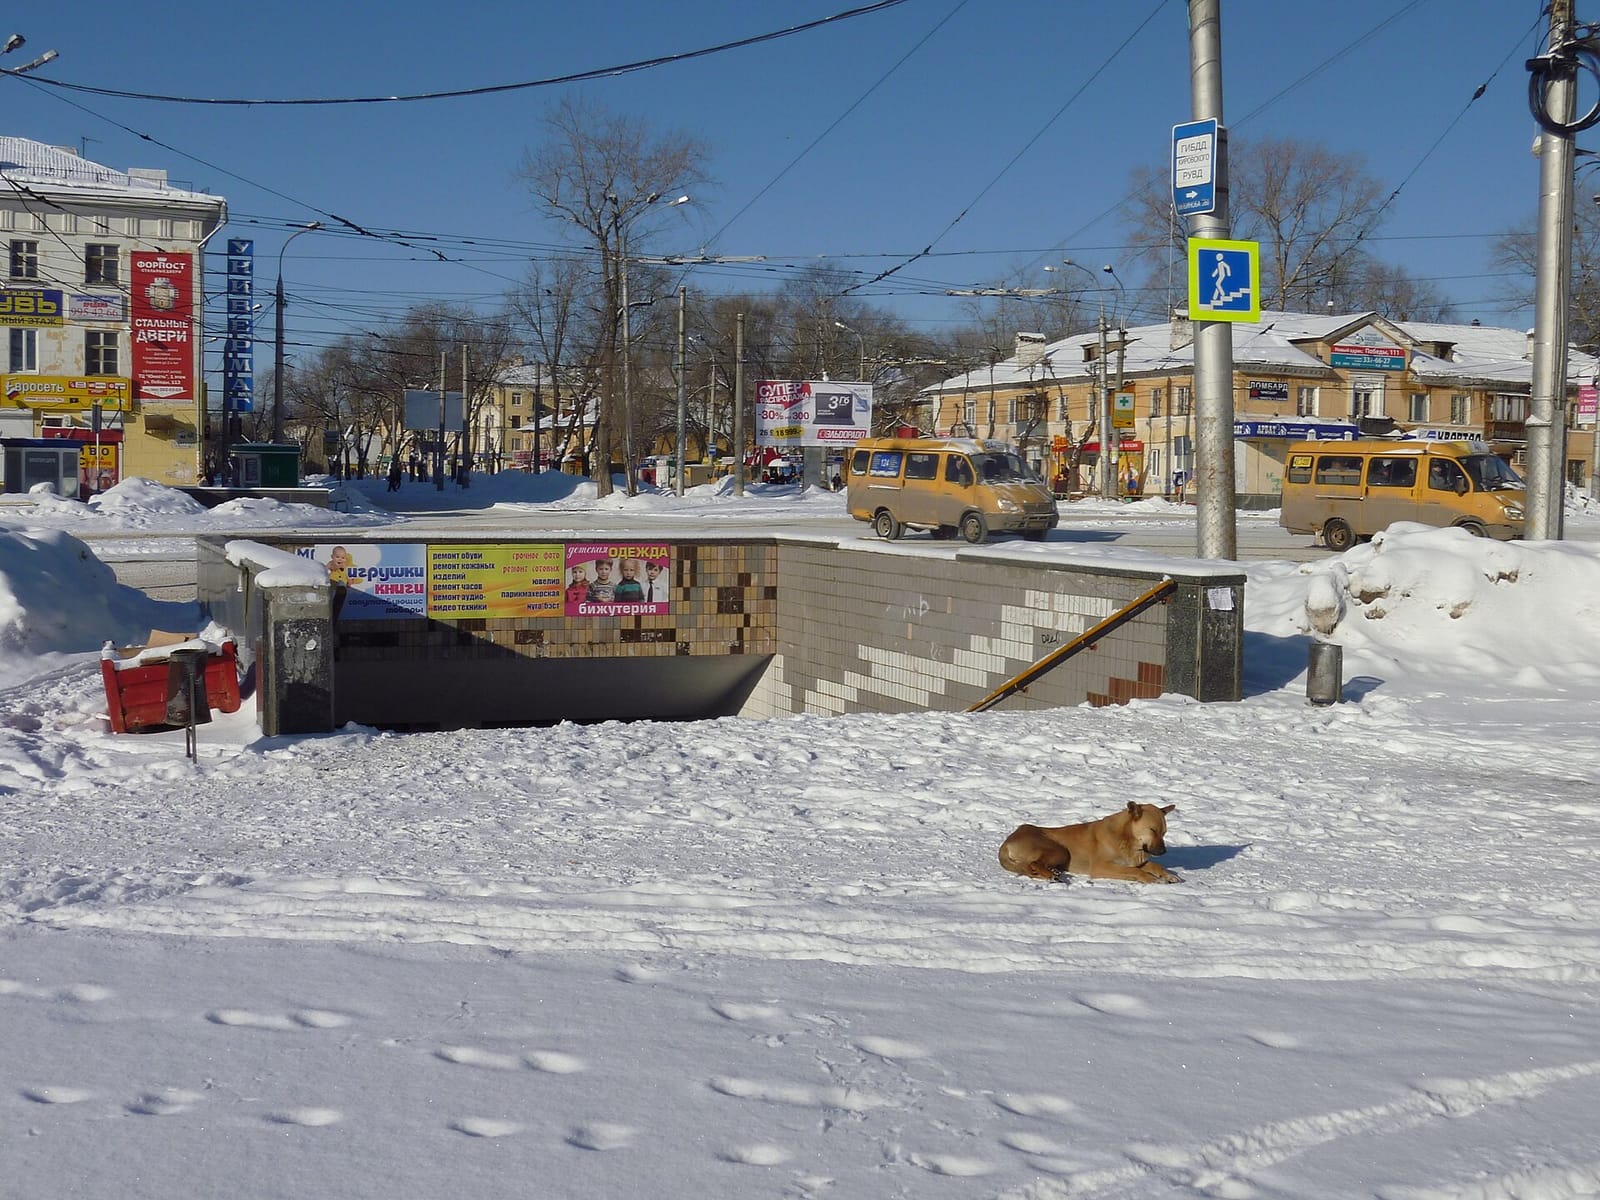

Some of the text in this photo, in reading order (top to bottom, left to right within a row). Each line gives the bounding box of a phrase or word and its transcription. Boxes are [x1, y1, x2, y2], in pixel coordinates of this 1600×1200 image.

[1181, 141, 1207, 152] ГИБДД
[1178, 154, 1210, 165] КИРОВСКОГО
[1182, 169, 1203, 180] РУВД
[137, 262, 186, 270] ФОРПОСТ
[135, 319, 189, 328] СТАЛЬНЫЕ
[136, 330, 187, 343] ДВЕРИ
[759, 383, 803, 397] СУПЕР
[1250, 382, 1288, 392] ЛОМБАРД
[828, 396, 838, 409] 3
[792, 411, 810, 420] 300
[433, 552, 482, 562] ремонт обуви
[543, 552, 560, 561] фото
[609, 547, 668, 559] ОДЕЖДА
[433, 563, 460, 571] ремонт
[503, 566, 528, 574] ремонт
[348, 567, 424, 582] игрушки
[532, 578, 560, 586] ювелир
[375, 584, 424, 595] книги
[501, 591, 560, 599] парикмахерская
[385, 607, 424, 615] товары
[433, 603, 487, 612] видео техники
[579, 603, 656, 616] бижутерия
